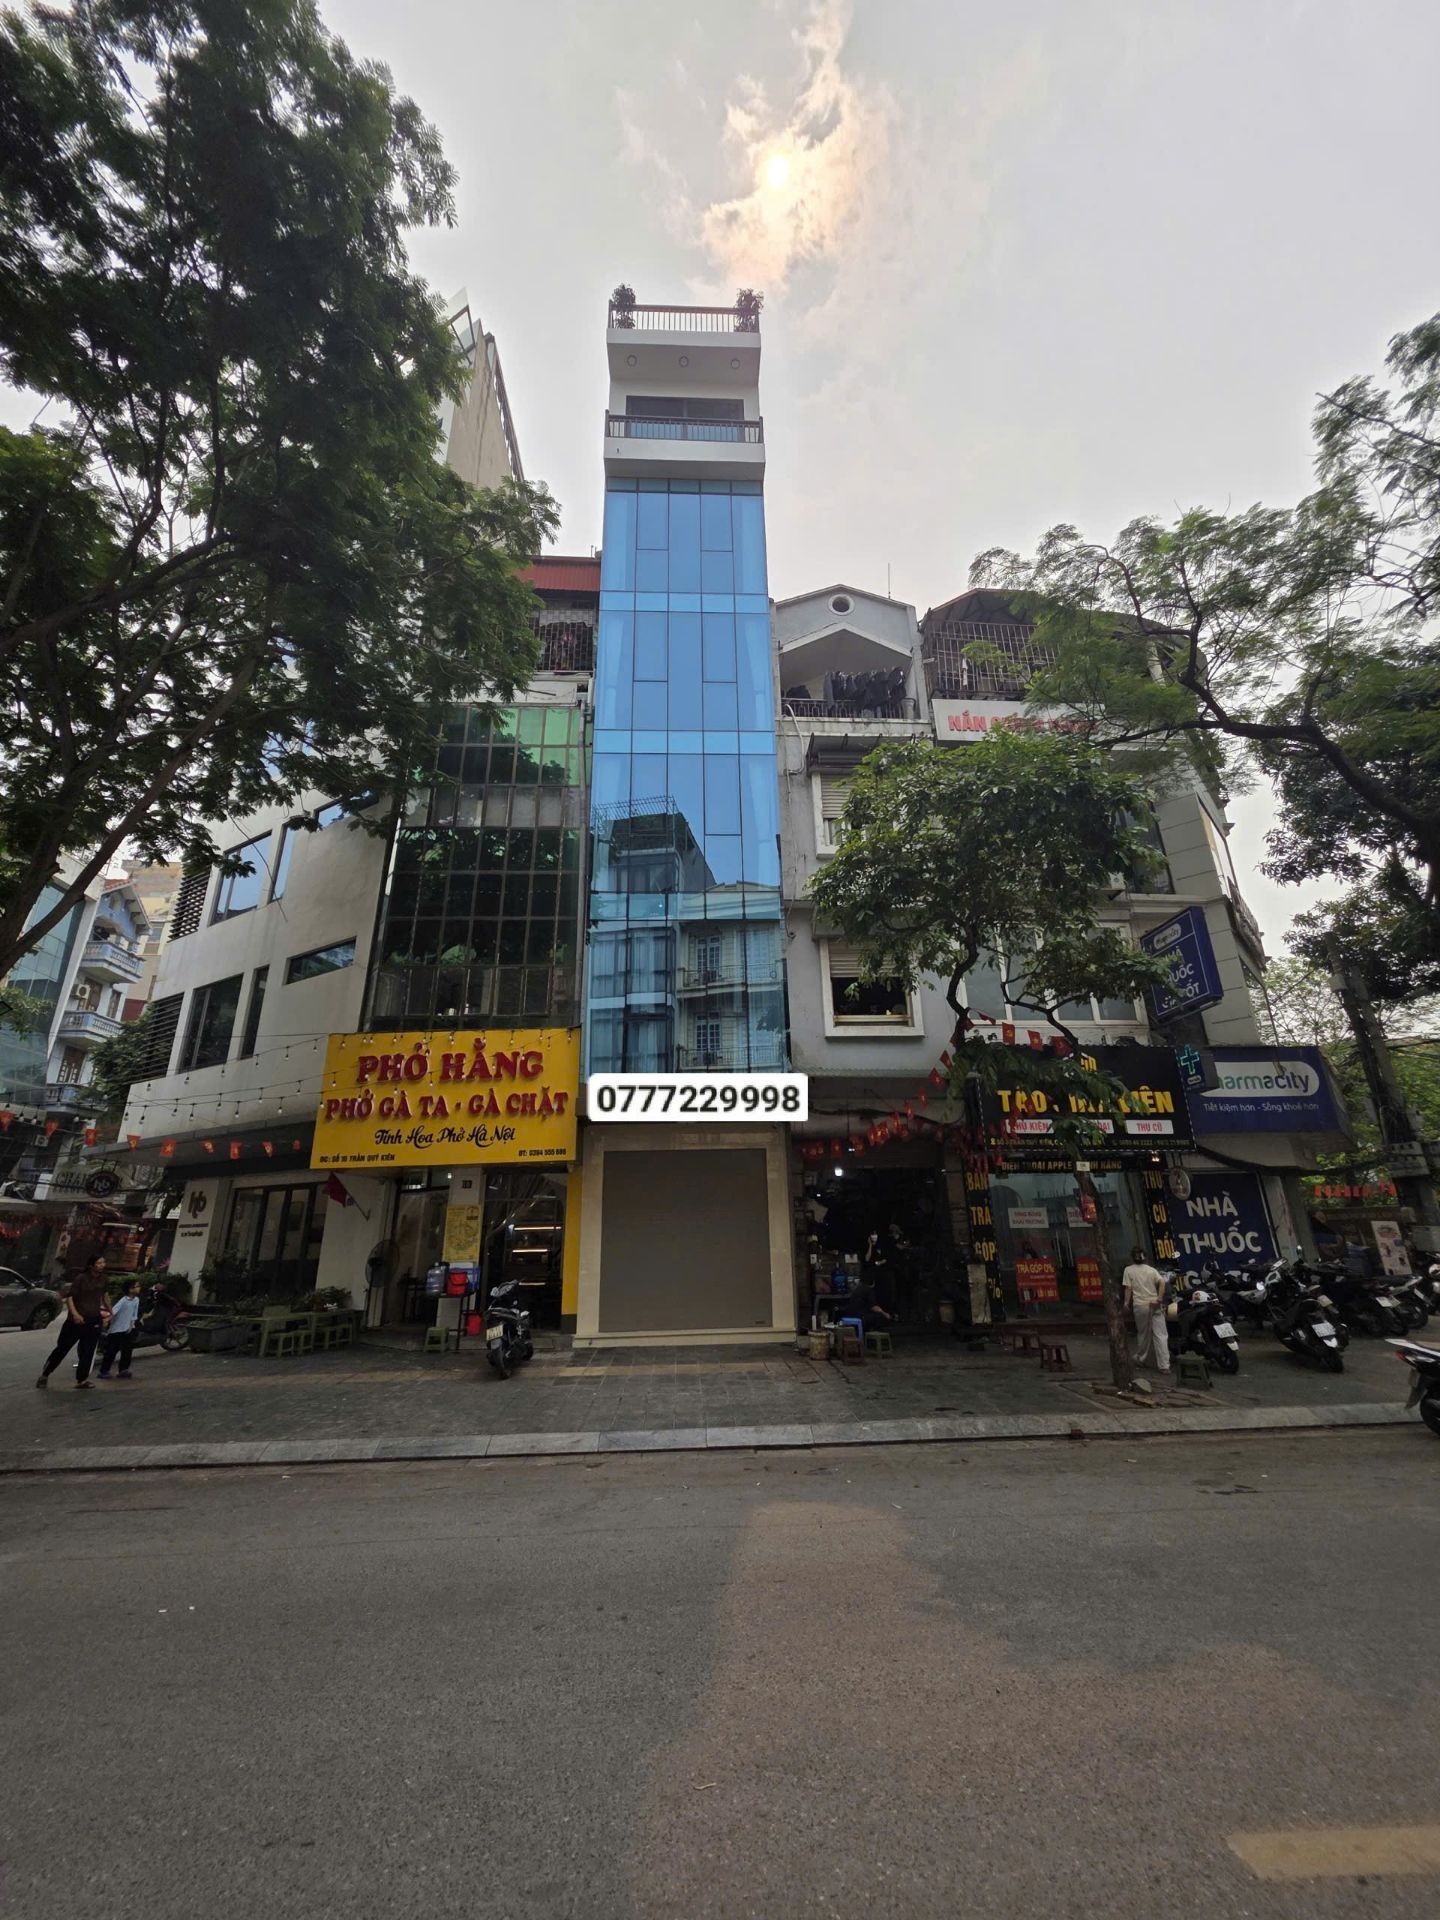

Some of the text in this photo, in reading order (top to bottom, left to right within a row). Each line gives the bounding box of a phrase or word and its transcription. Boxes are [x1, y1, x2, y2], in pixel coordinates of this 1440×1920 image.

[326, 1088, 374, 1120] PHỞ
[380, 1090, 412, 1119] GÀ
[419, 1095, 449, 1118] TA
[468, 1087, 500, 1117] GÀ
[406, 1125, 433, 1148] Hoa
[1048, 1160, 1072, 1170] APPLE
[1186, 1190, 1238, 1217] NHÀ
[1178, 1220, 1262, 1254] THUỐC
